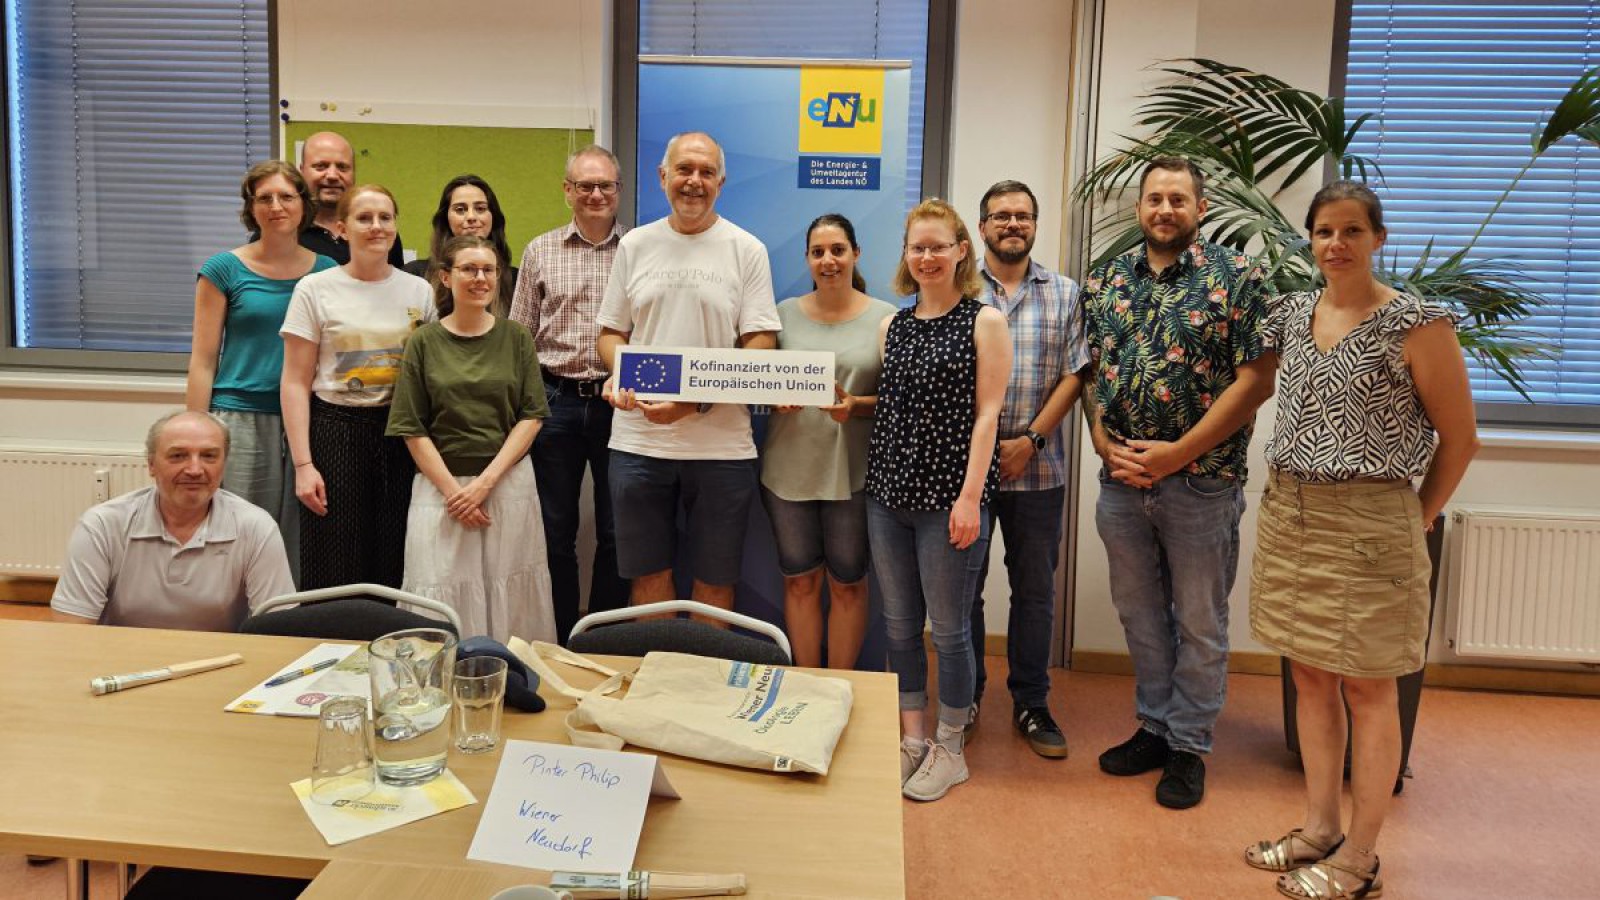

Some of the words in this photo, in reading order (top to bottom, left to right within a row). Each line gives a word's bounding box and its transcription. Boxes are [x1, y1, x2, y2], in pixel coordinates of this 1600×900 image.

[811, 160, 825, 168] Die
[826, 160, 860, 170] Energie-
[862, 161, 868, 169] &
[810, 169, 867, 179] Umweltagentur
[855, 177, 867, 186] NÖ
[689, 359, 771, 374] Kofinanziert
[775, 364, 800, 374] von
[803, 364, 826, 375] der
[688, 376, 782, 390] Europäischen
[786, 379, 826, 391] Union
[522, 754, 568, 776] Pinter
[575, 762, 621, 788] Philip
[519, 799, 564, 822] Wiener
[526, 828, 592, 860] Neudorf
